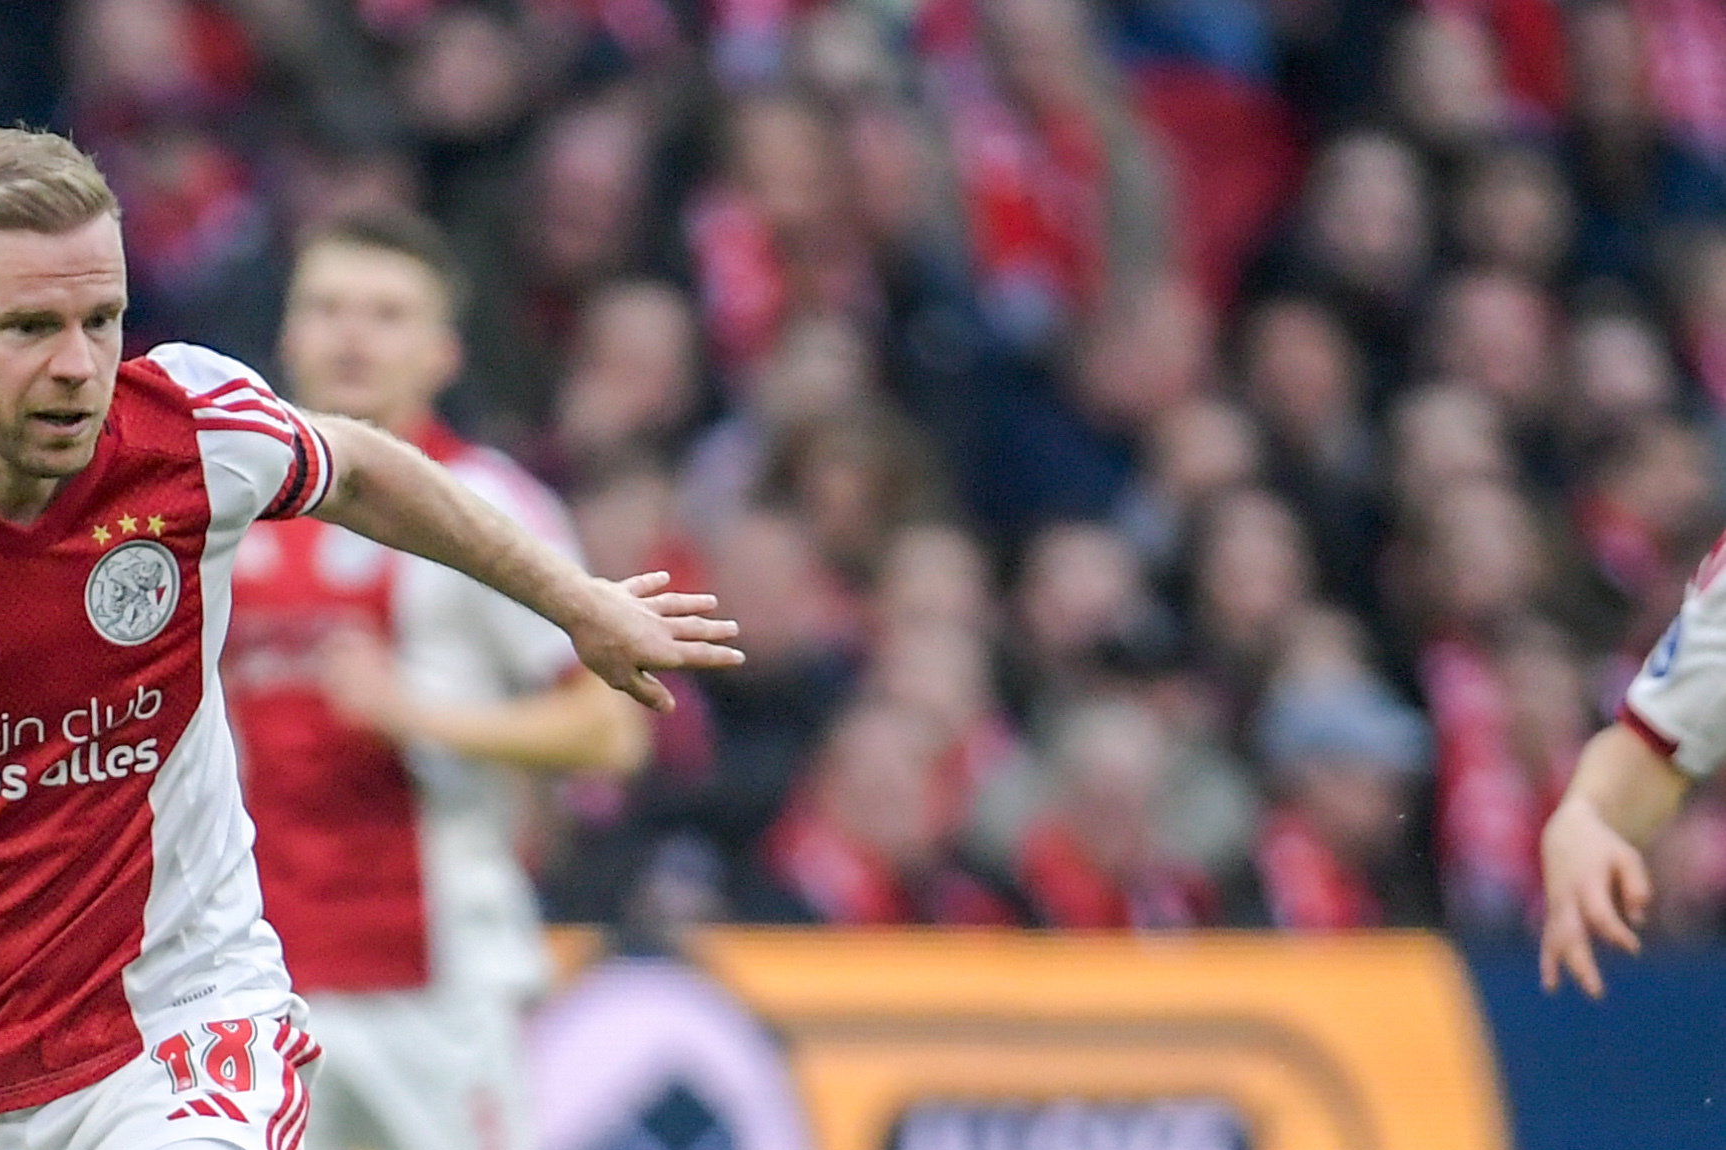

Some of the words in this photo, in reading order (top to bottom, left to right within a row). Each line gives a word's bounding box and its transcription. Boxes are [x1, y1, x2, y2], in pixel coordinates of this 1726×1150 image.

[62, 684, 163, 744] club
[38, 738, 160, 786] alles
[150, 1016, 259, 1095] 18
